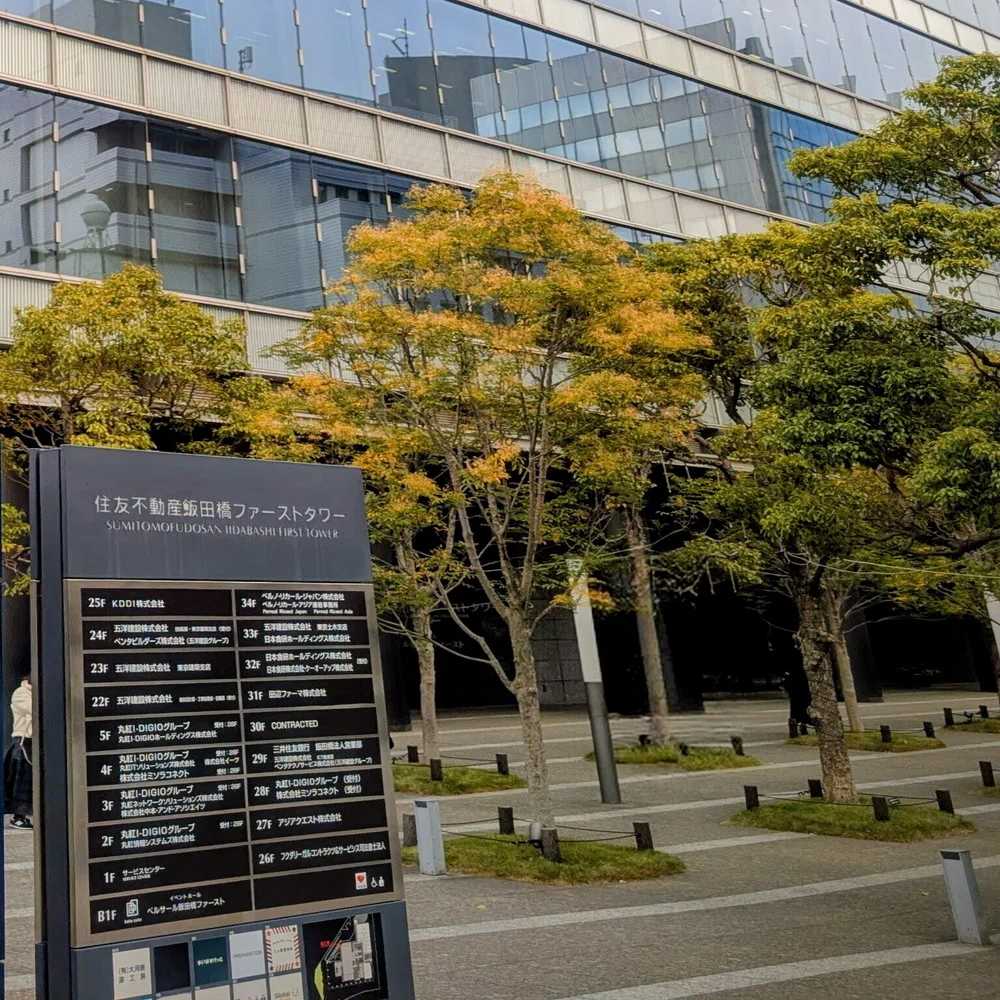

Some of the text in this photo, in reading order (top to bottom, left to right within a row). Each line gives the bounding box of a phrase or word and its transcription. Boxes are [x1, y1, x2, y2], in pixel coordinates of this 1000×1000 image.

[94, 494, 345, 522] 住友不動産飯田橋ファーストタワー
[279, 527, 302, 537] FIRST
[306, 528, 338, 539] TOWER
[88, 598, 165, 608] 25F KDDI株式会社
[241, 598, 256, 608] 34F
[114, 624, 169, 632] 五洋建設株式会社
[264, 623, 312, 631] 五洋建設株式会社
[90, 630, 107, 640] 24F
[243, 629, 259, 639] 33F
[90, 663, 108, 673] 23F
[115, 663, 171, 673] 五洋建設株式会社
[245, 660, 261, 669] 32F
[92, 696, 110, 707] 22F
[116, 694, 172, 705] 五洋建設株式会社
[248, 691, 263, 700] 31F
[250, 720, 318, 732] 30F CONTRACTED
[100, 731, 111, 741] 5F
[273, 744, 310, 754] 三井住友銀行
[252, 754, 268, 764] 29F
[101, 765, 112, 775] 4F
[254, 786, 270, 797] 28F
[102, 800, 113, 811] 3F
[256, 813, 342, 830] 27F アジアクエスト株式会社
[102, 836, 114, 847] 2F
[259, 853, 275, 864] 26F
[122, 865, 165, 876] サービスセンター
[104, 872, 115, 883] 1F
[147, 897, 225, 914] ベルサール飯田橋ファースト
[98, 910, 116, 922] B1F
[274, 991, 290, 999] Global
